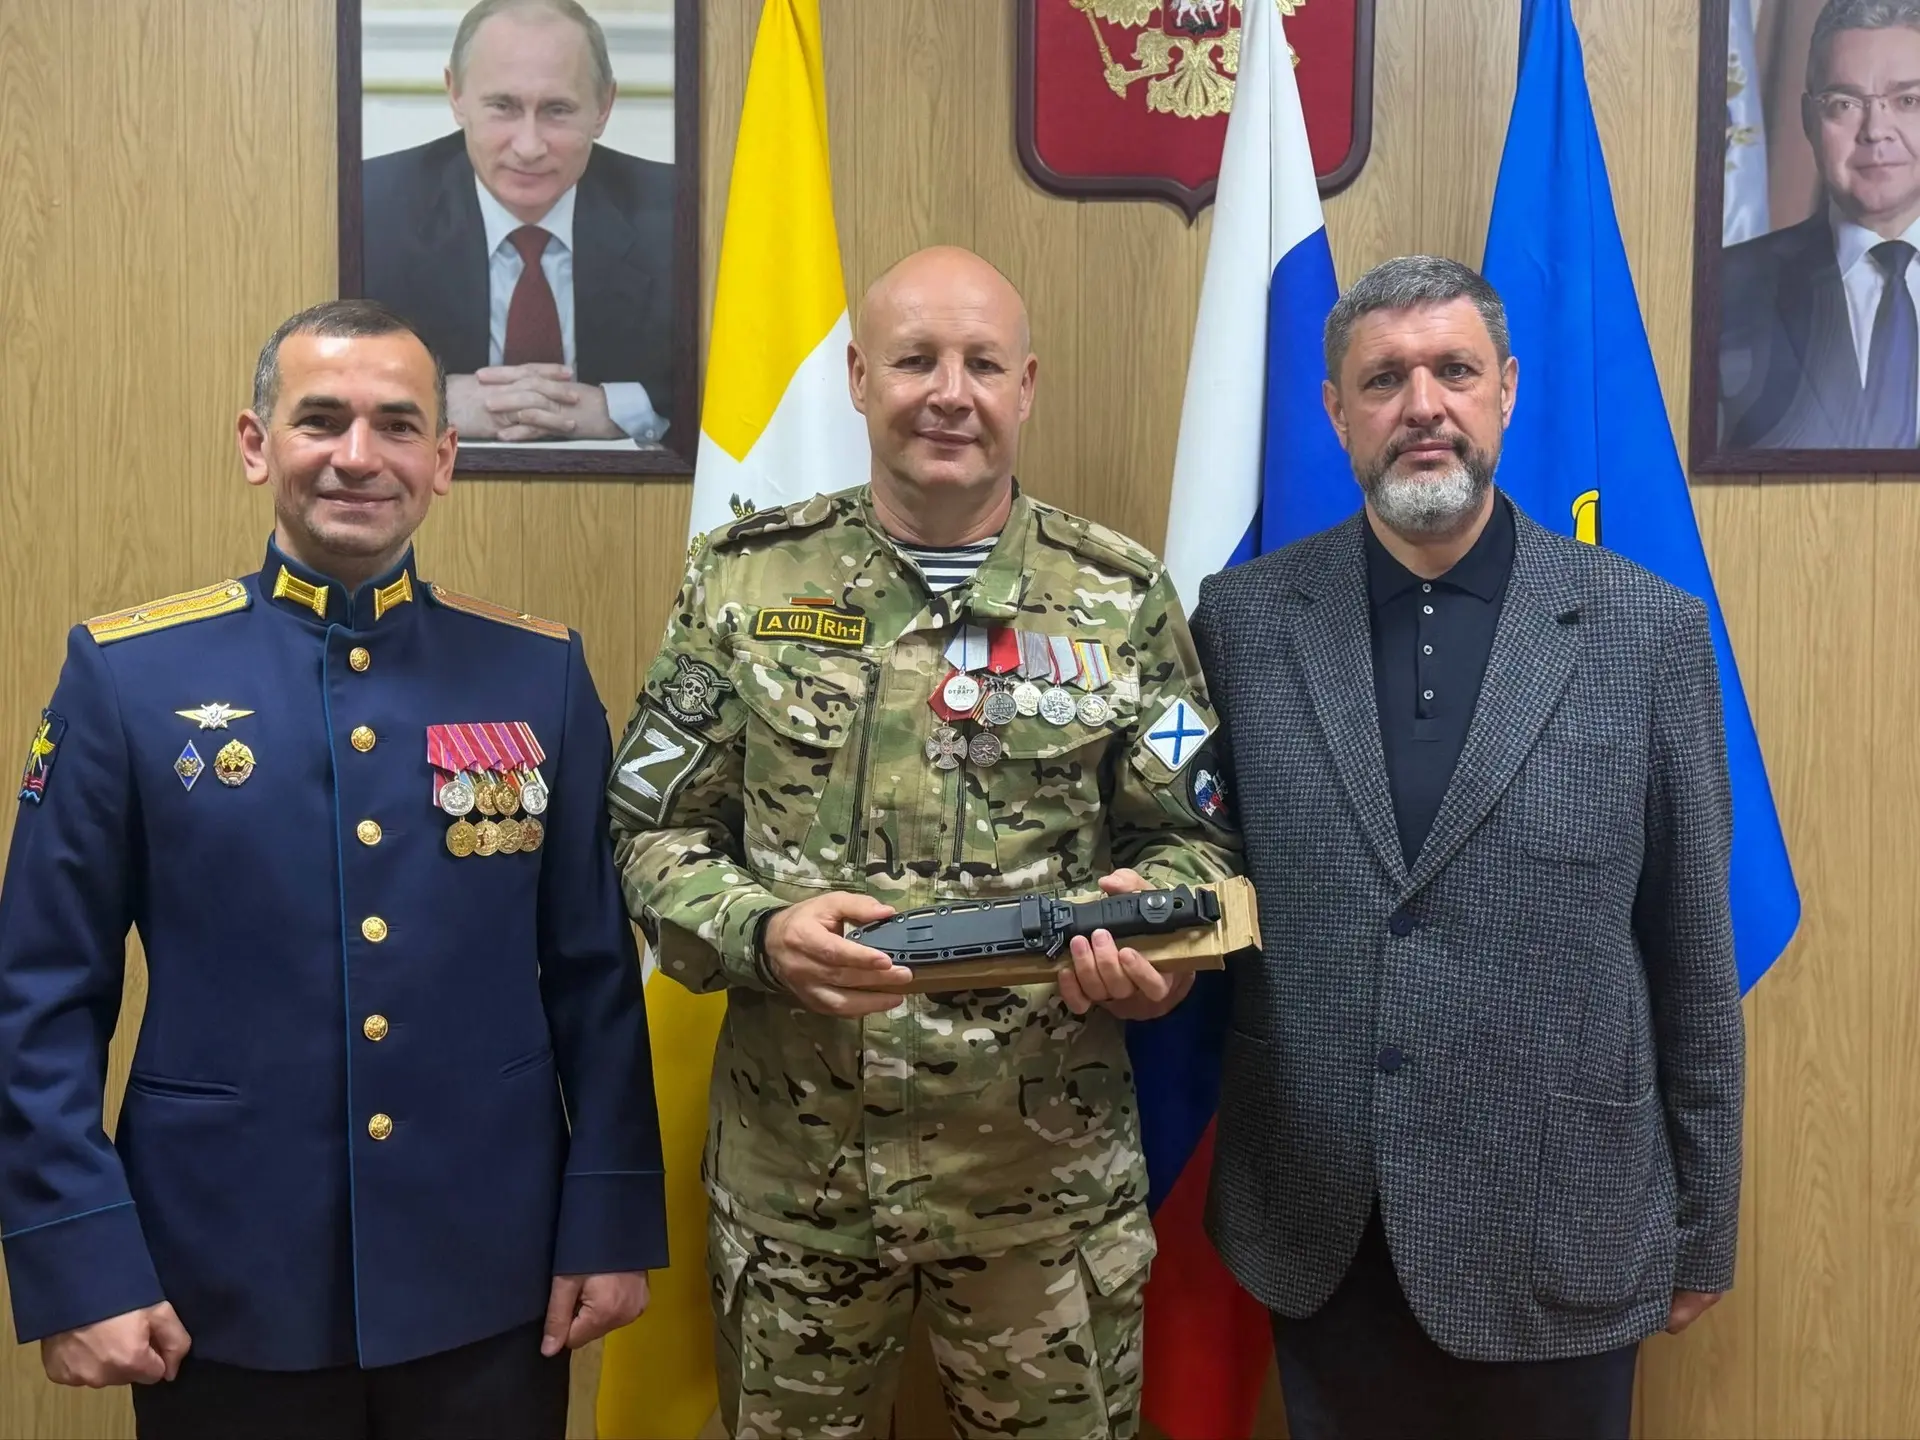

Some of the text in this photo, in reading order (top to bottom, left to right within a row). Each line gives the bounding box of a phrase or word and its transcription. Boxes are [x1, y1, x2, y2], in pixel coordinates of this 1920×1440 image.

[766, 615, 783, 630] A
[823, 618, 860, 637] Rh+
[618, 728, 686, 803] Z
